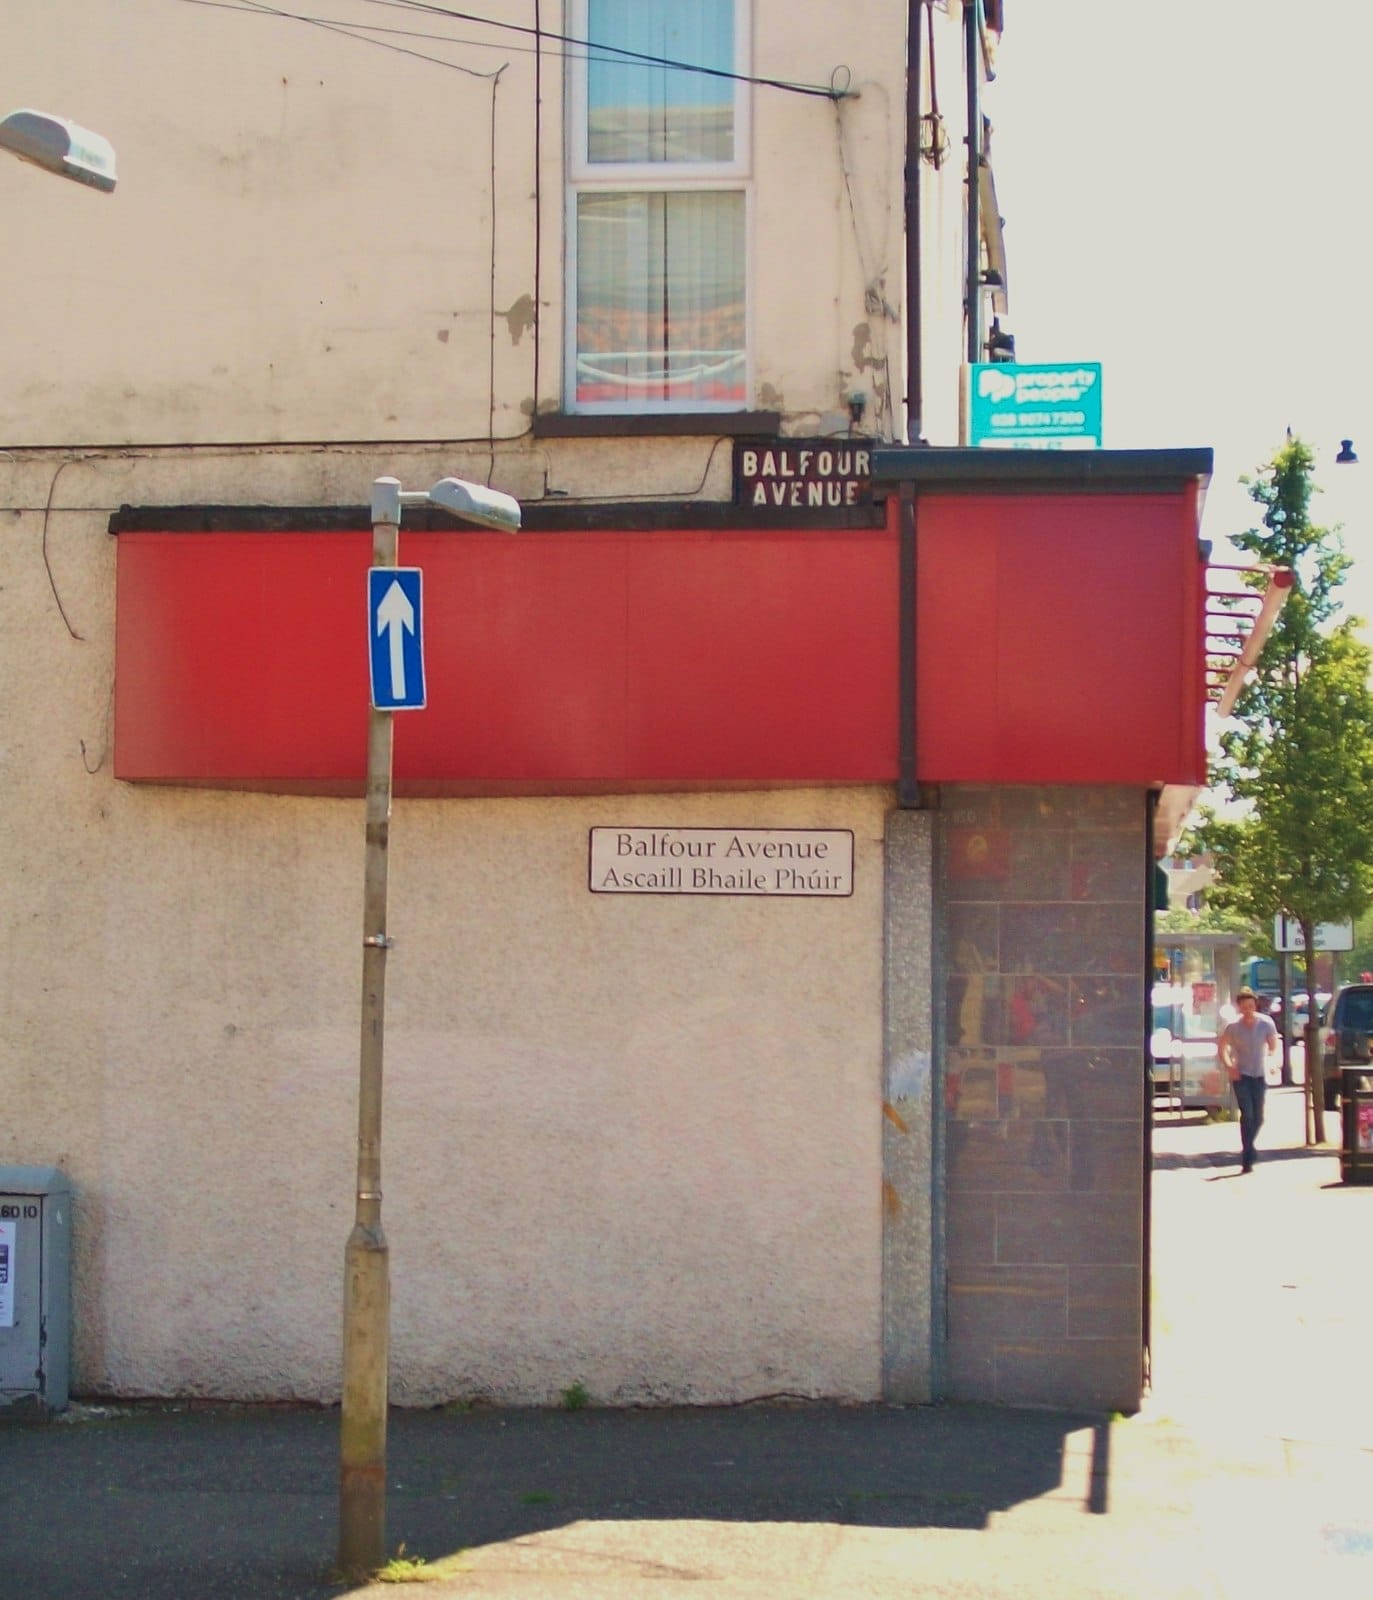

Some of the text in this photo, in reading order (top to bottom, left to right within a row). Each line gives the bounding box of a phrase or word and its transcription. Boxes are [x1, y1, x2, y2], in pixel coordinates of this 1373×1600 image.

[743, 450, 870, 477] BALFOUR
[752, 481, 858, 506] AVENUE
[616, 832, 829, 859] Balfour Avenue
[601, 866, 843, 891] Ascaill Bhaile Phúir
